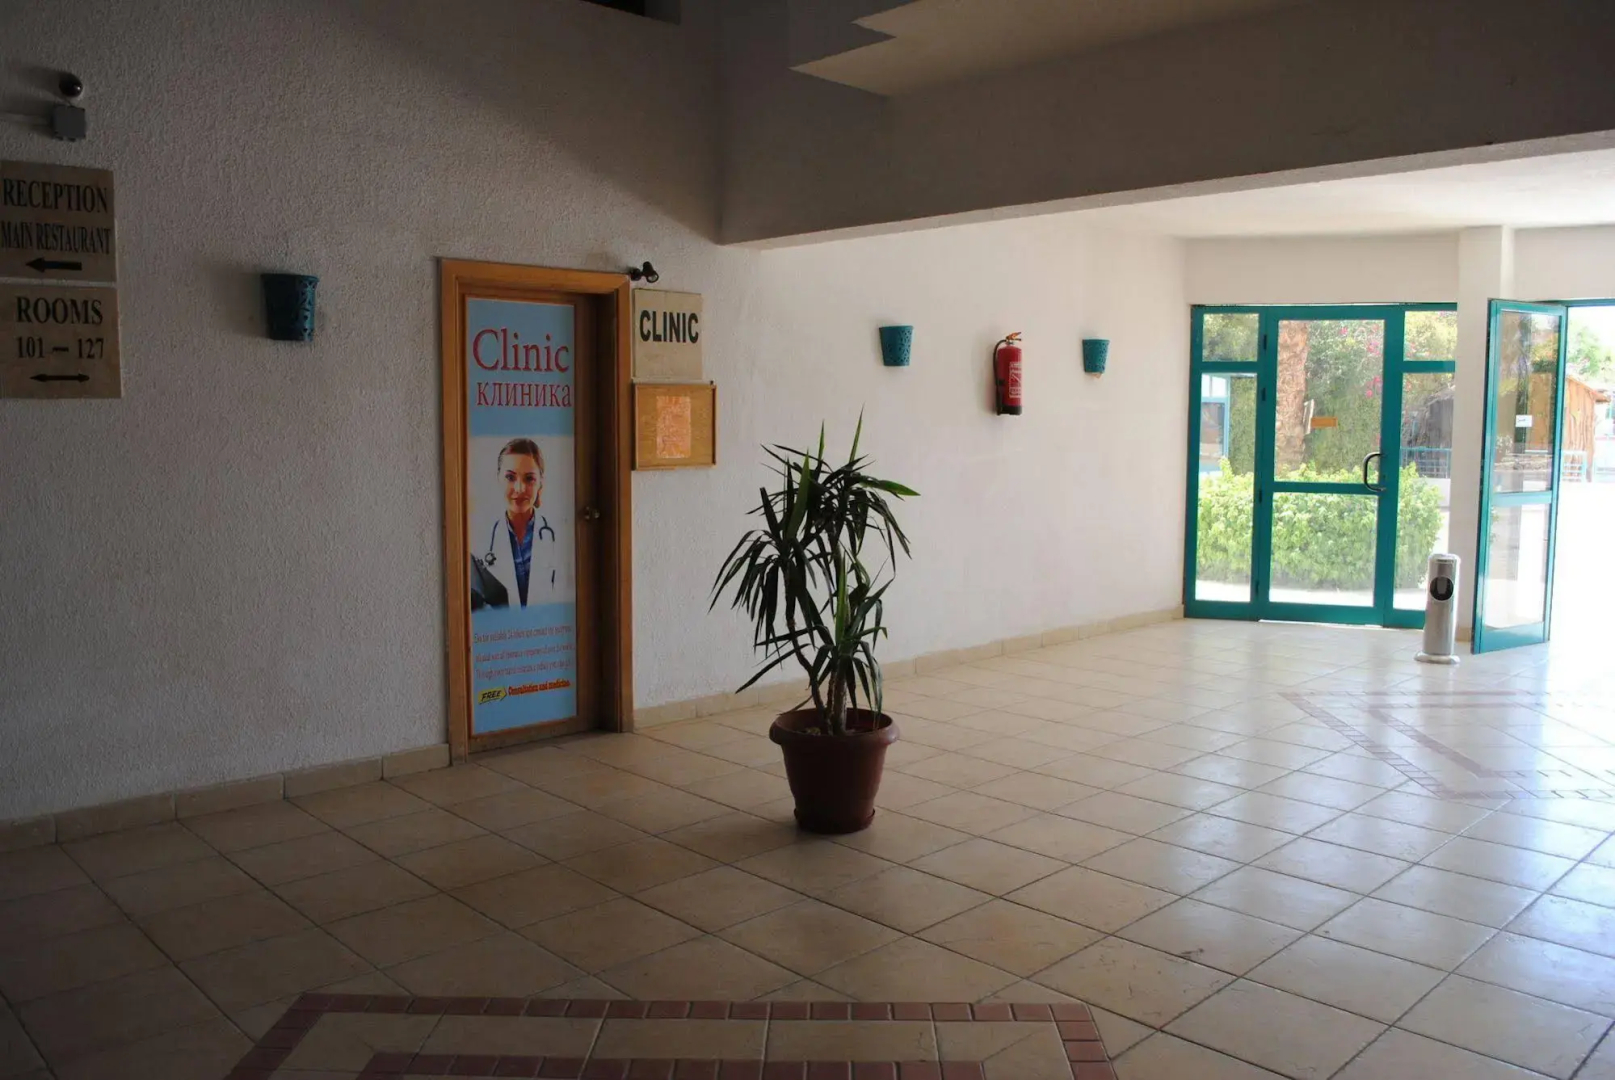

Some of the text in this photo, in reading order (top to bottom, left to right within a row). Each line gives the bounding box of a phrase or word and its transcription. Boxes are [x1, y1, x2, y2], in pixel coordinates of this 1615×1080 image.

[3, 178, 108, 213] RECEPTION
[1, 220, 110, 255] MAIN RESTAURANT
[16, 296, 103, 325] ROOMS
[639, 309, 699, 343] CLINIC
[17, 336, 44, 358] 101
[77, 338, 104, 359] 127
[472, 327, 570, 373] Clinic
[476, 381, 572, 407] клиника
[481, 690, 502, 701] FREE
